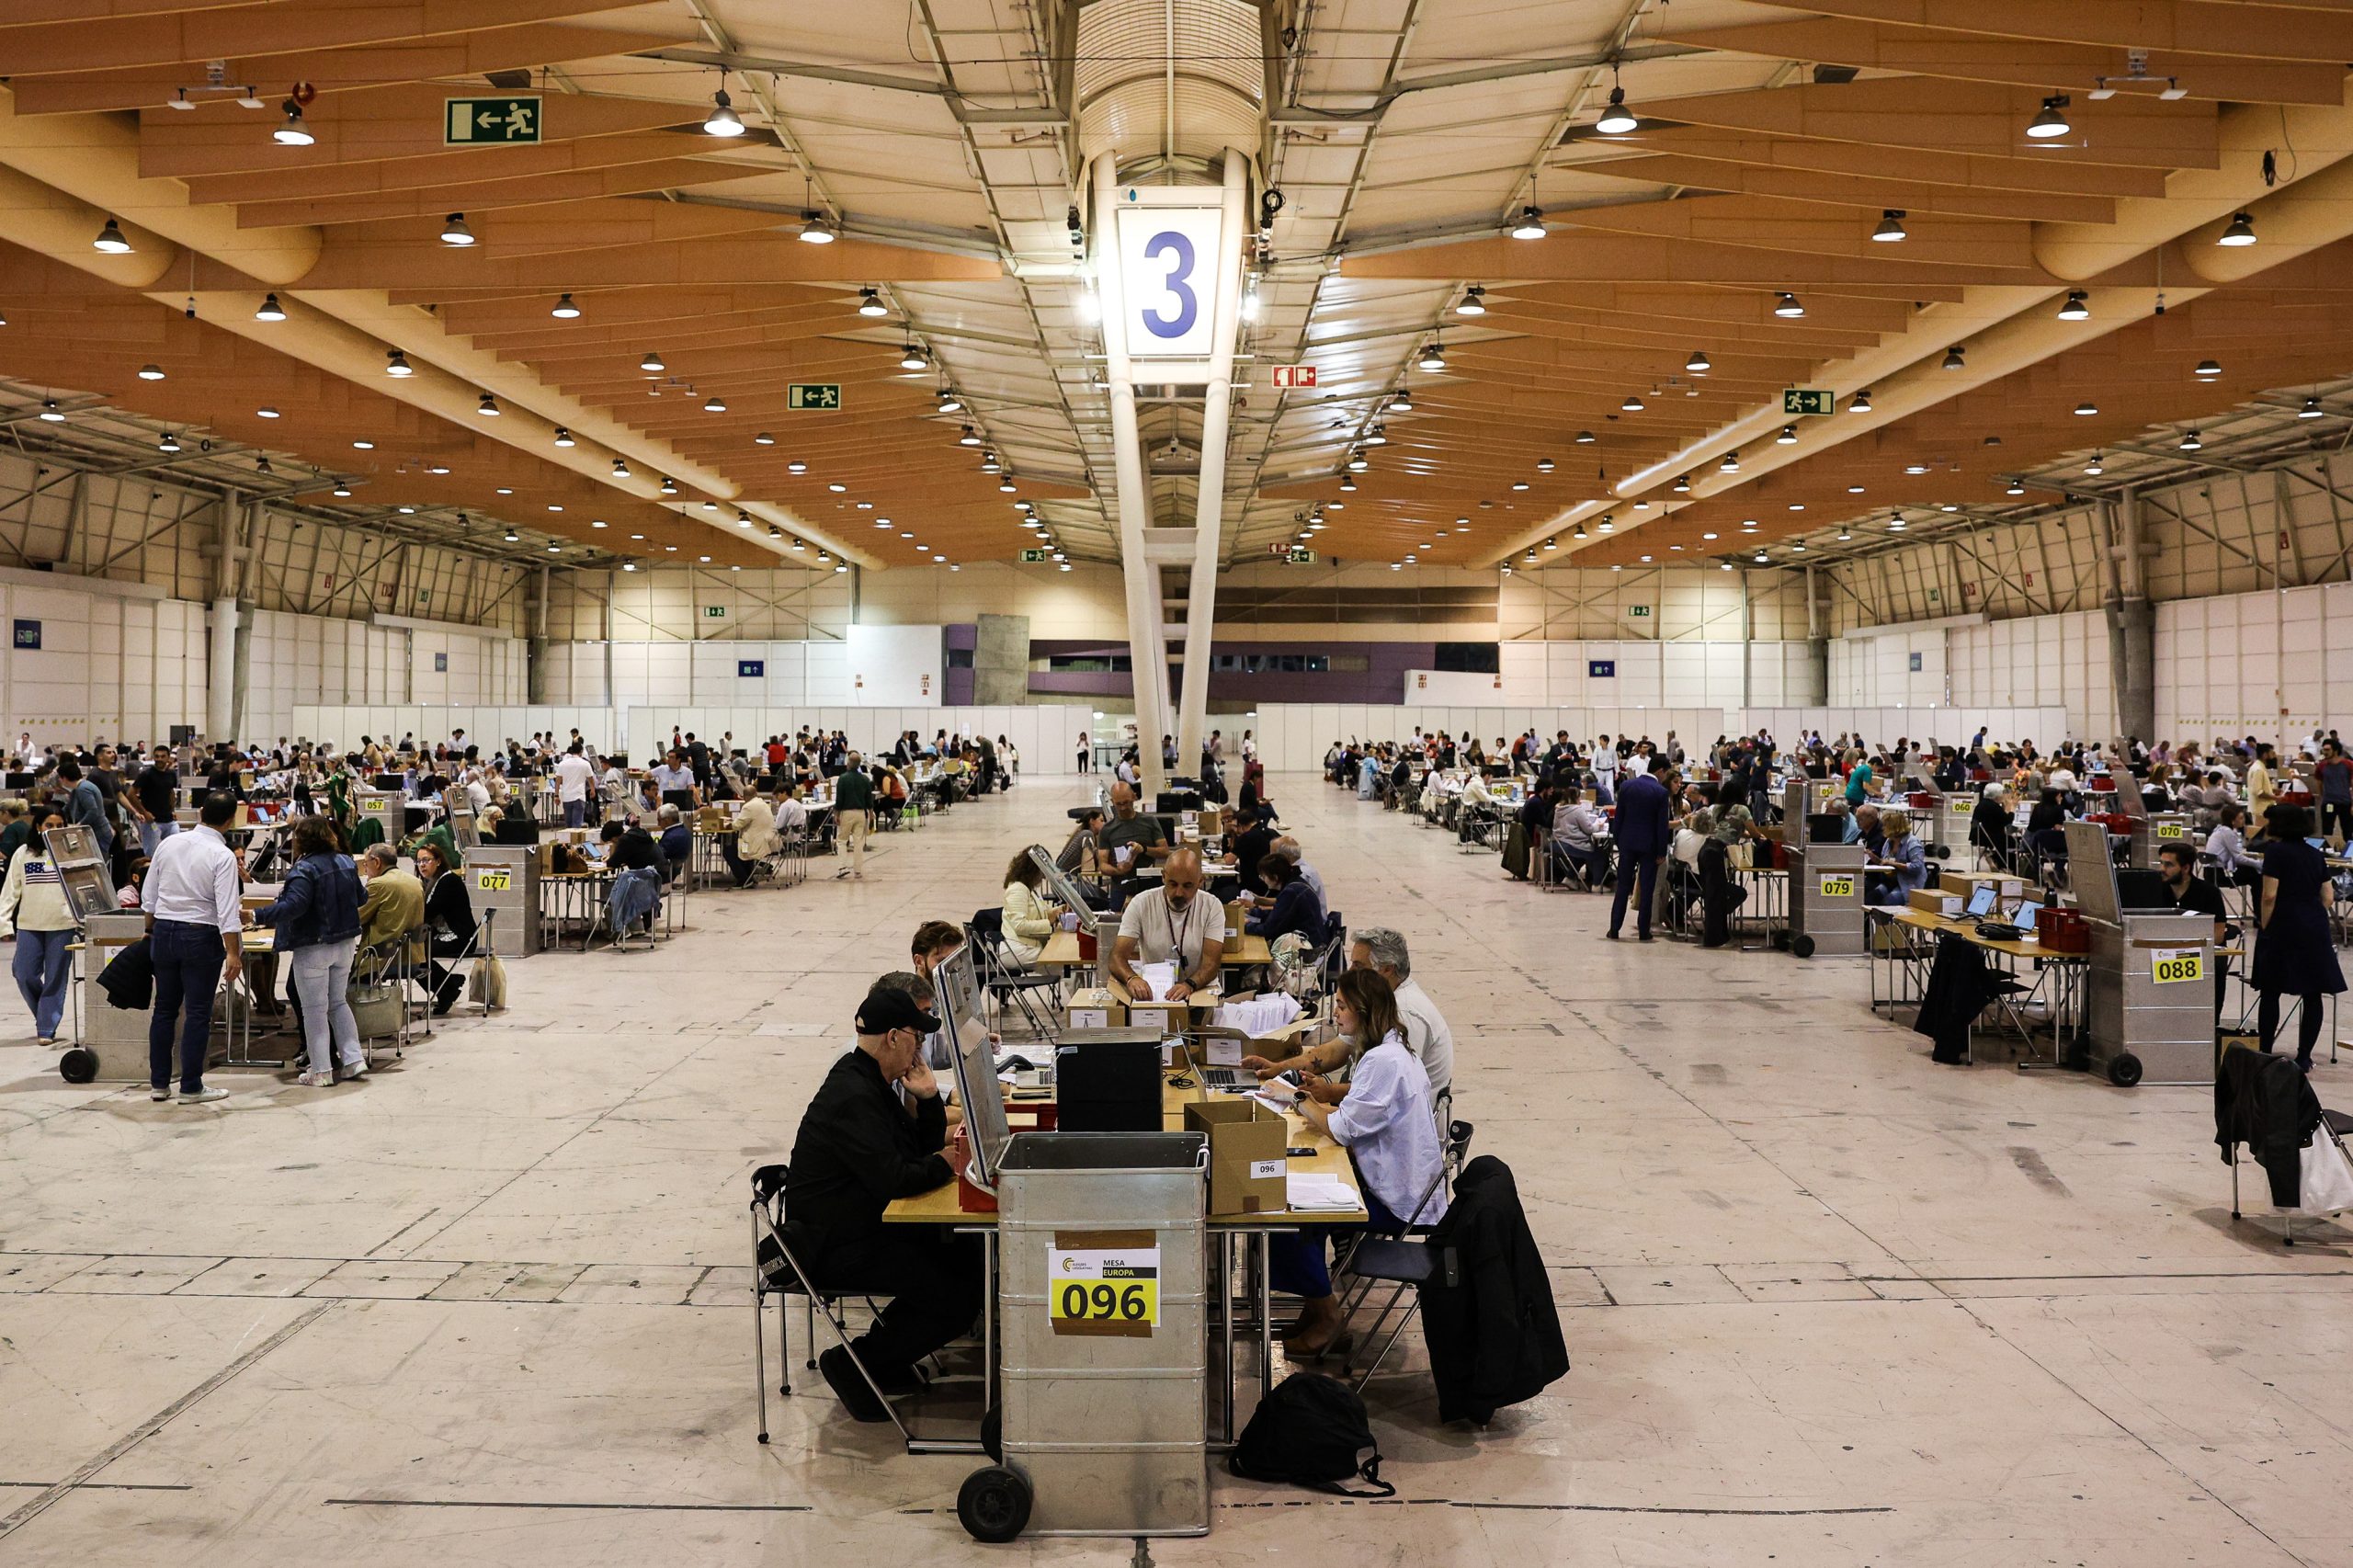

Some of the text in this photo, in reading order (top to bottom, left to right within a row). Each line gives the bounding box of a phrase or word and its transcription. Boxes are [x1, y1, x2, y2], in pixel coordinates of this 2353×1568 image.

[1142, 231, 1198, 339] 3
[367, 801, 382, 810] 057
[2161, 826, 2179, 836] 070
[482, 876, 506, 888] 077
[1824, 882, 1849, 894] 079
[2159, 960, 2197, 980] 088
[1260, 1165, 1275, 1173] 096
[1063, 1284, 1146, 1321] 096
